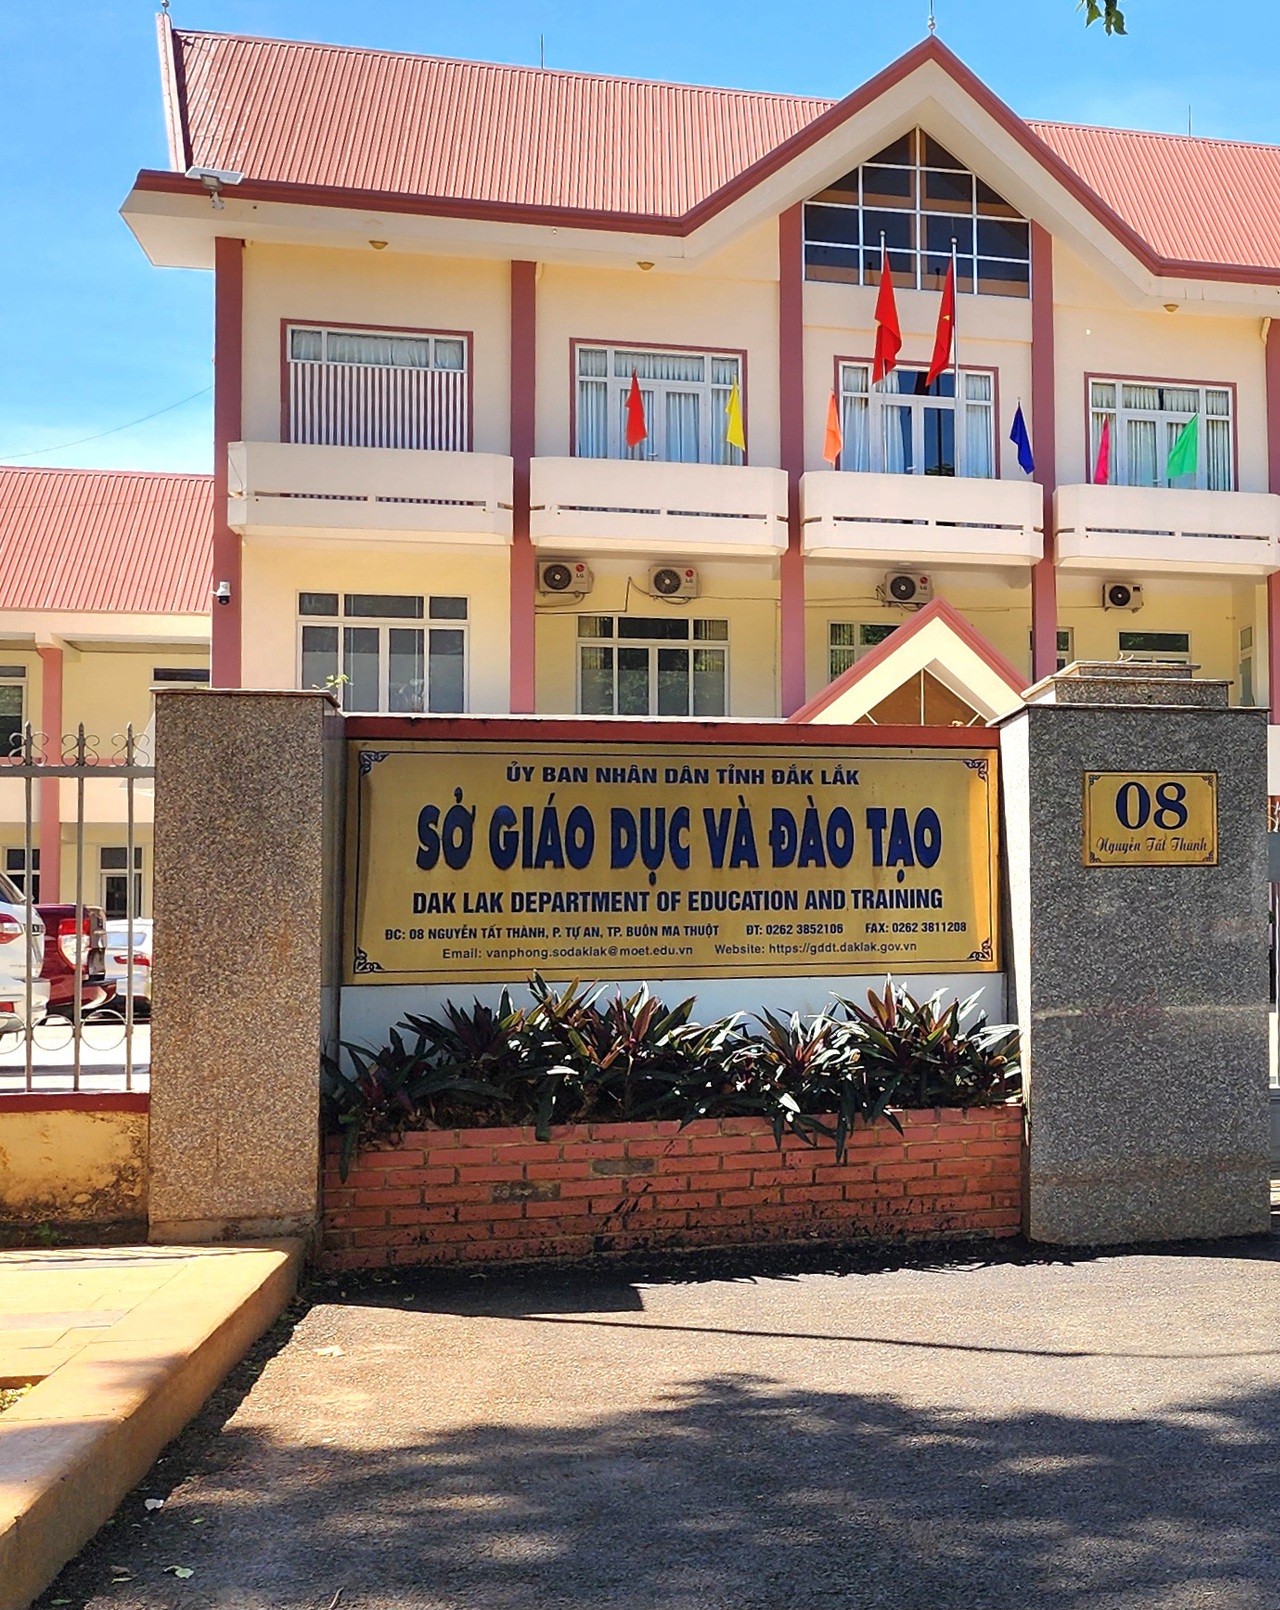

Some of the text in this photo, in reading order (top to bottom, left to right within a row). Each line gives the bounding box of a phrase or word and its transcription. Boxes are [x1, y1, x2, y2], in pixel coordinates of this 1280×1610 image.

[506, 761, 860, 786] ỦY BAN NHÂN DÂN TỈNH ĐẮK LẮK
[1115, 782, 1188, 830] 08
[416, 787, 942, 887] SỞ GIÁO DỤC VÀ ĐÀO TẠO
[1096, 837, 1141, 854] Nguyễn
[1146, 836, 1167, 852] Tất
[413, 889, 943, 914] DAK LAK DEPARTMENT OF EDUCATION AND TRAINING
[385, 923, 719, 940] ĐC: 08 NGUYỄN TẤT THÀNH, P. TỰ AN, TP. BUÔN MA THUỘT
[746, 923, 844, 935] ĐT: 0262 3852106
[865, 922, 967, 934] FAX: 0262 3811208
[442, 946, 693, 960] Email: vanphong.sodaklak@moet.edu.vn
[714, 942, 917, 956] Website: https://gddt.daklak.gov.vn
